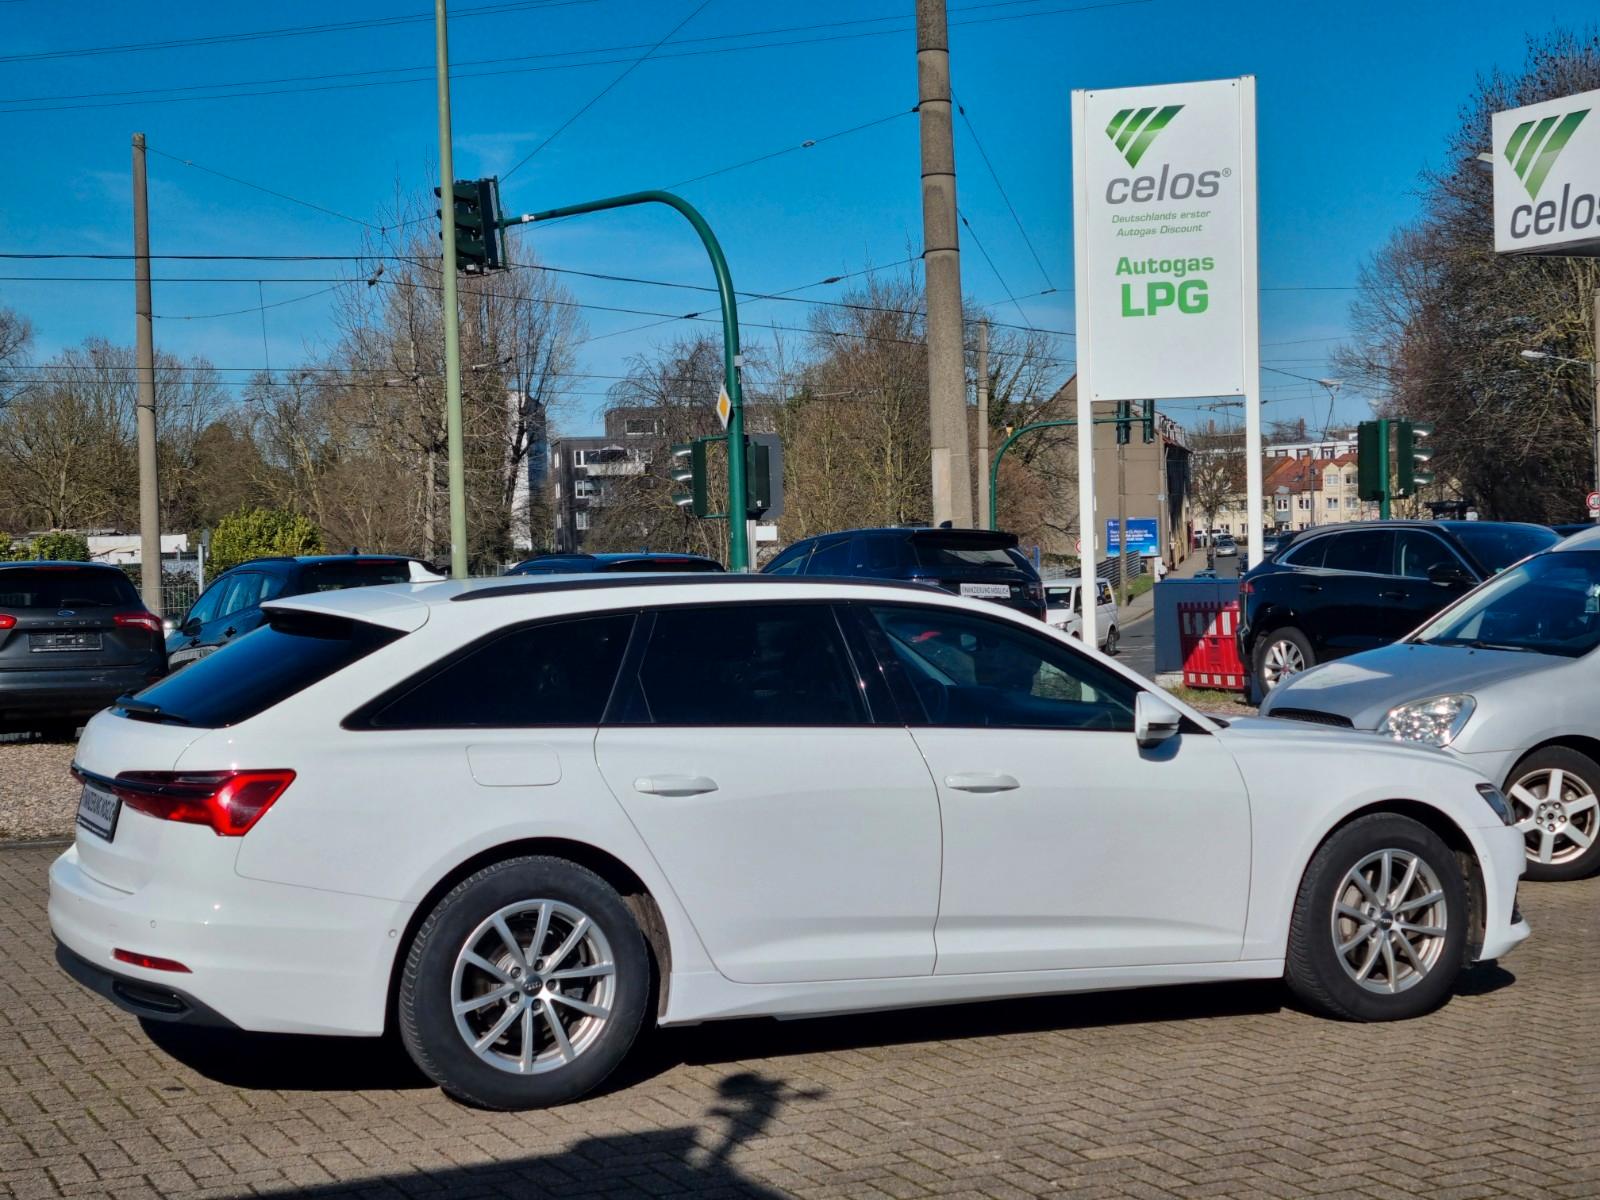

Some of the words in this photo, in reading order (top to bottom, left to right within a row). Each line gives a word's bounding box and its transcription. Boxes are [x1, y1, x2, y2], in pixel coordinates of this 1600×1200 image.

[1111, 211, 1177, 224] Deutschlands
[1180, 210, 1211, 219] erster
[1510, 183, 1600, 239] celo
[1116, 228, 1157, 238] Autogas
[1160, 223, 1203, 234] Discount
[1115, 256, 1215, 277] Autogas
[1121, 279, 1209, 317] LPG
